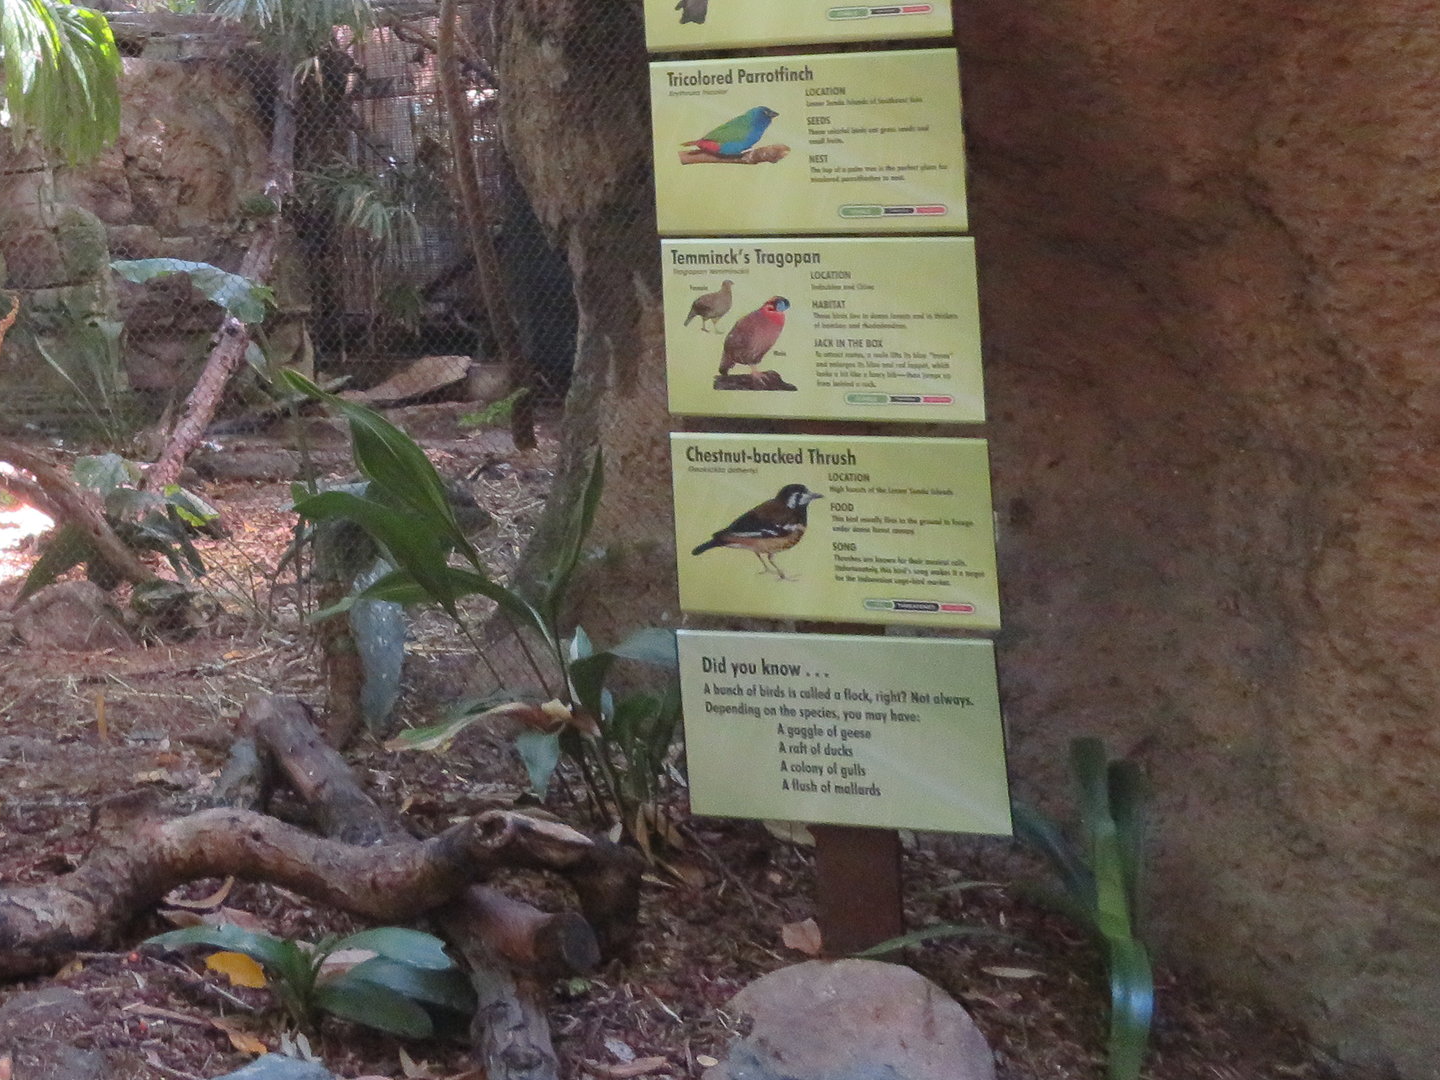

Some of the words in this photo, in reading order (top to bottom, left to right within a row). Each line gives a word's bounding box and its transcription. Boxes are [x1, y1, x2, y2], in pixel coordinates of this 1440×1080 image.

[667, 69, 733, 87] Tricolored
[737, 65, 813, 84] Parrotfinch
[805, 87, 846, 97] LOCATION
[806, 116, 831, 126] SEEDS
[809, 154, 828, 164] NEST
[671, 248, 750, 265] Temminck's
[754, 249, 821, 268] Tragopan
[810, 270, 851, 280] LOCATION
[812, 300, 846, 309] HABITAT
[814, 339, 833, 348] JACK
[836, 339, 846, 348] IN
[848, 339, 863, 348] THE
[866, 339, 883, 348] BOX
[686, 446, 803, 465] Chestnut-backed
[807, 447, 857, 466] Thrush
[828, 472, 870, 482] LOCATION
[830, 502, 854, 512] FOOD
[832, 542, 857, 552] SONG
[702, 656, 726, 673] Did
[731, 662, 757, 678] you
[761, 658, 801, 676] know
[703, 683, 711, 695] A
[713, 684, 743, 696] bunch
[747, 685, 757, 696] of
[760, 685, 785, 698] birds
[788, 687, 796, 698] is
[800, 687, 831, 700] called
[834, 691, 841, 700] a
[844, 688, 872, 704] flock,
[875, 690, 907, 705] right?
[911, 691, 930, 704] Not
[933, 692, 974, 708] always.
[705, 701, 761, 718] Depending
[764, 706, 776, 716] on
[779, 704, 796, 716] the
[799, 706, 840, 720] species,
[843, 710, 861, 721] you
[865, 711, 887, 723] may
[891, 708, 920, 722] have:
[777, 723, 784, 735] A
[787, 724, 823, 739] gaggle
[827, 725, 837, 737] of
[841, 728, 871, 741] geese
[779, 741, 786, 753] A
[789, 742, 807, 754] raft
[811, 742, 820, 755] of
[824, 743, 853, 757] ducks
[780, 760, 788, 772] A
[791, 761, 823, 775] colony
[827, 762, 837, 775] of
[841, 763, 866, 778] gulls
[782, 778, 789, 791] A
[792, 779, 817, 792] flush
[821, 781, 830, 793] of
[835, 782, 881, 796] mallards
